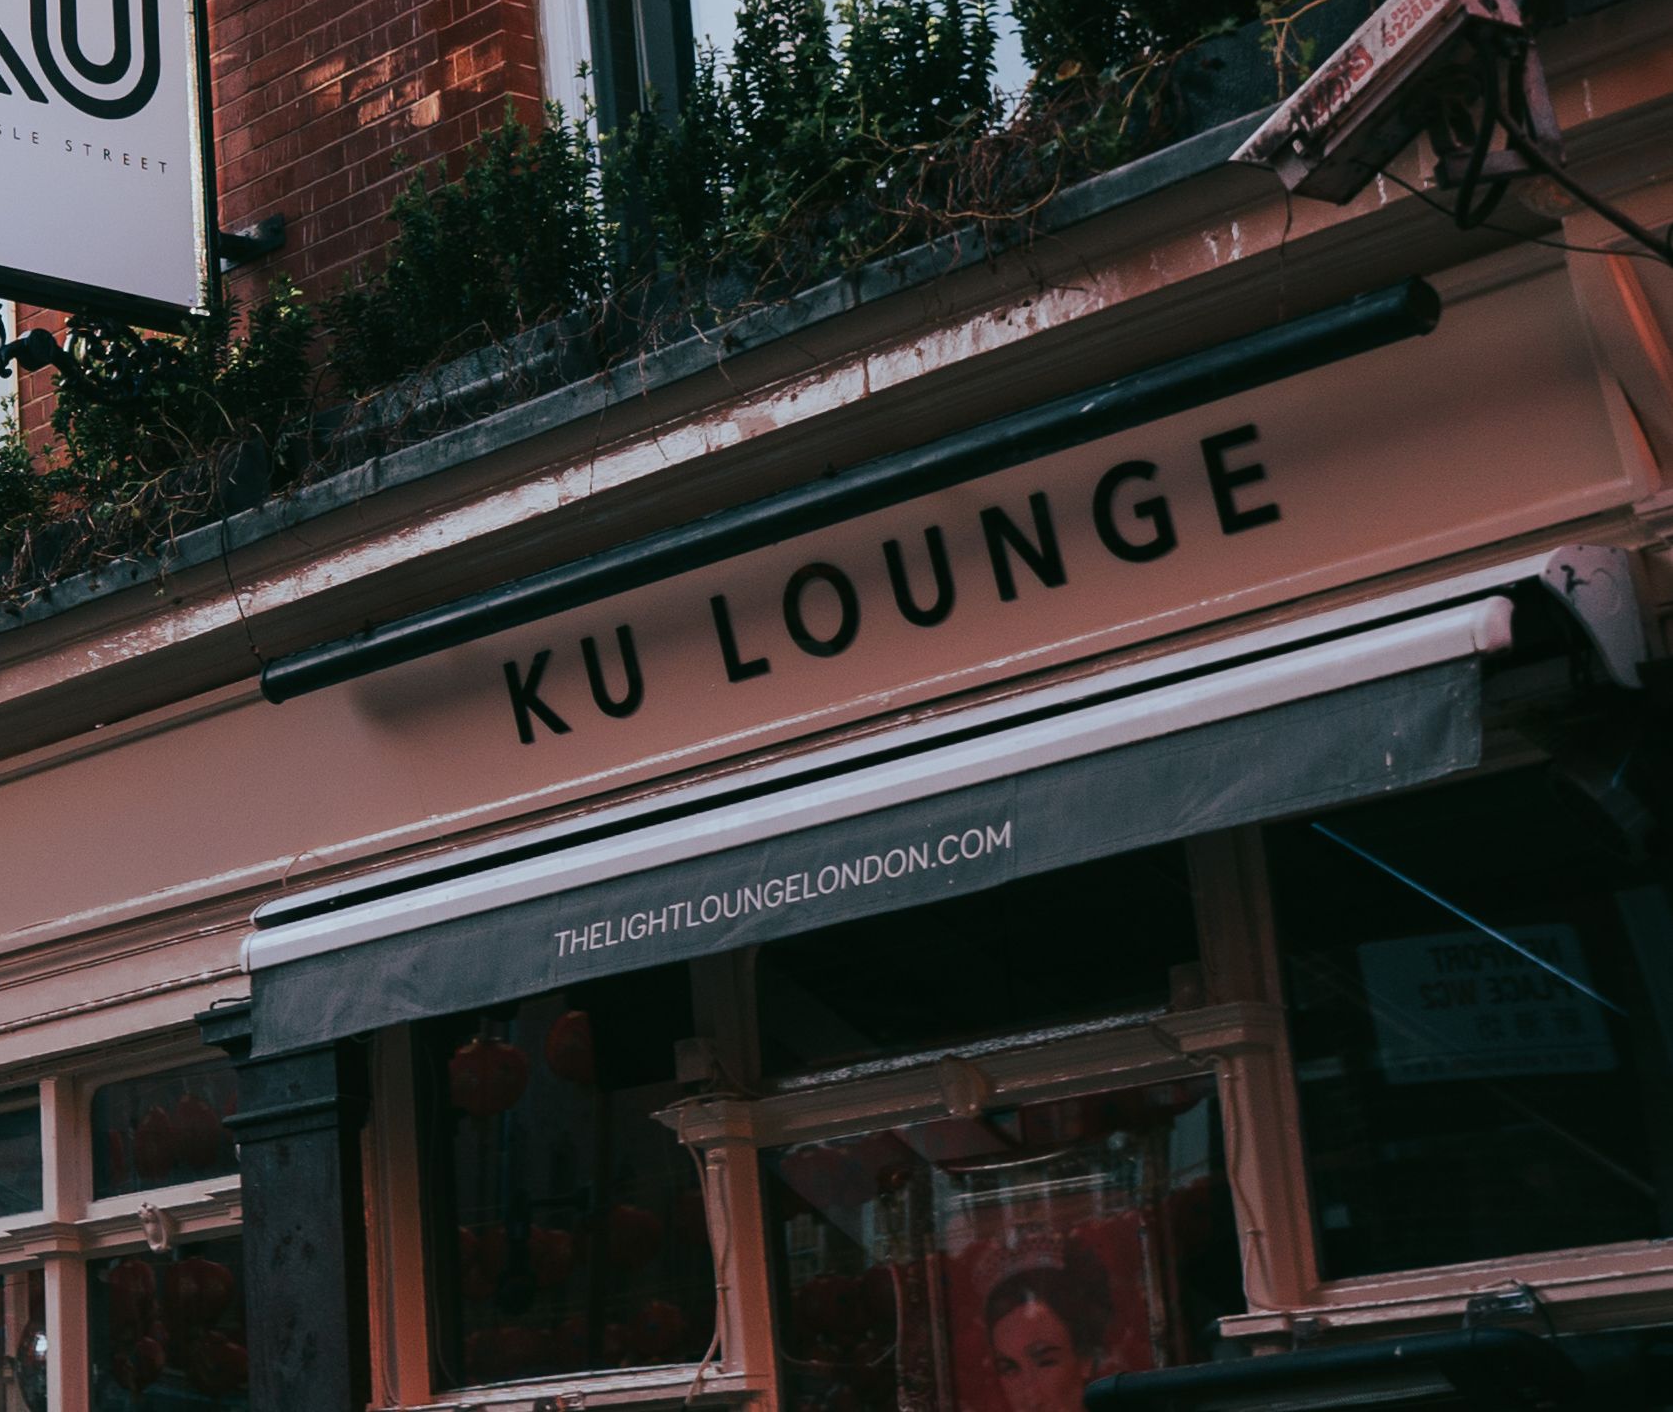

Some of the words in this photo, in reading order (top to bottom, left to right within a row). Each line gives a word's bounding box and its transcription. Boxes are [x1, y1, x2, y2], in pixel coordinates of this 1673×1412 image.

[64, 138, 169, 174] STREET
[501, 623, 648, 746] KU
[708, 421, 1284, 685] LOUNGE
[553, 819, 1013, 957] THELIGHTLOUNGELONDON.COM
